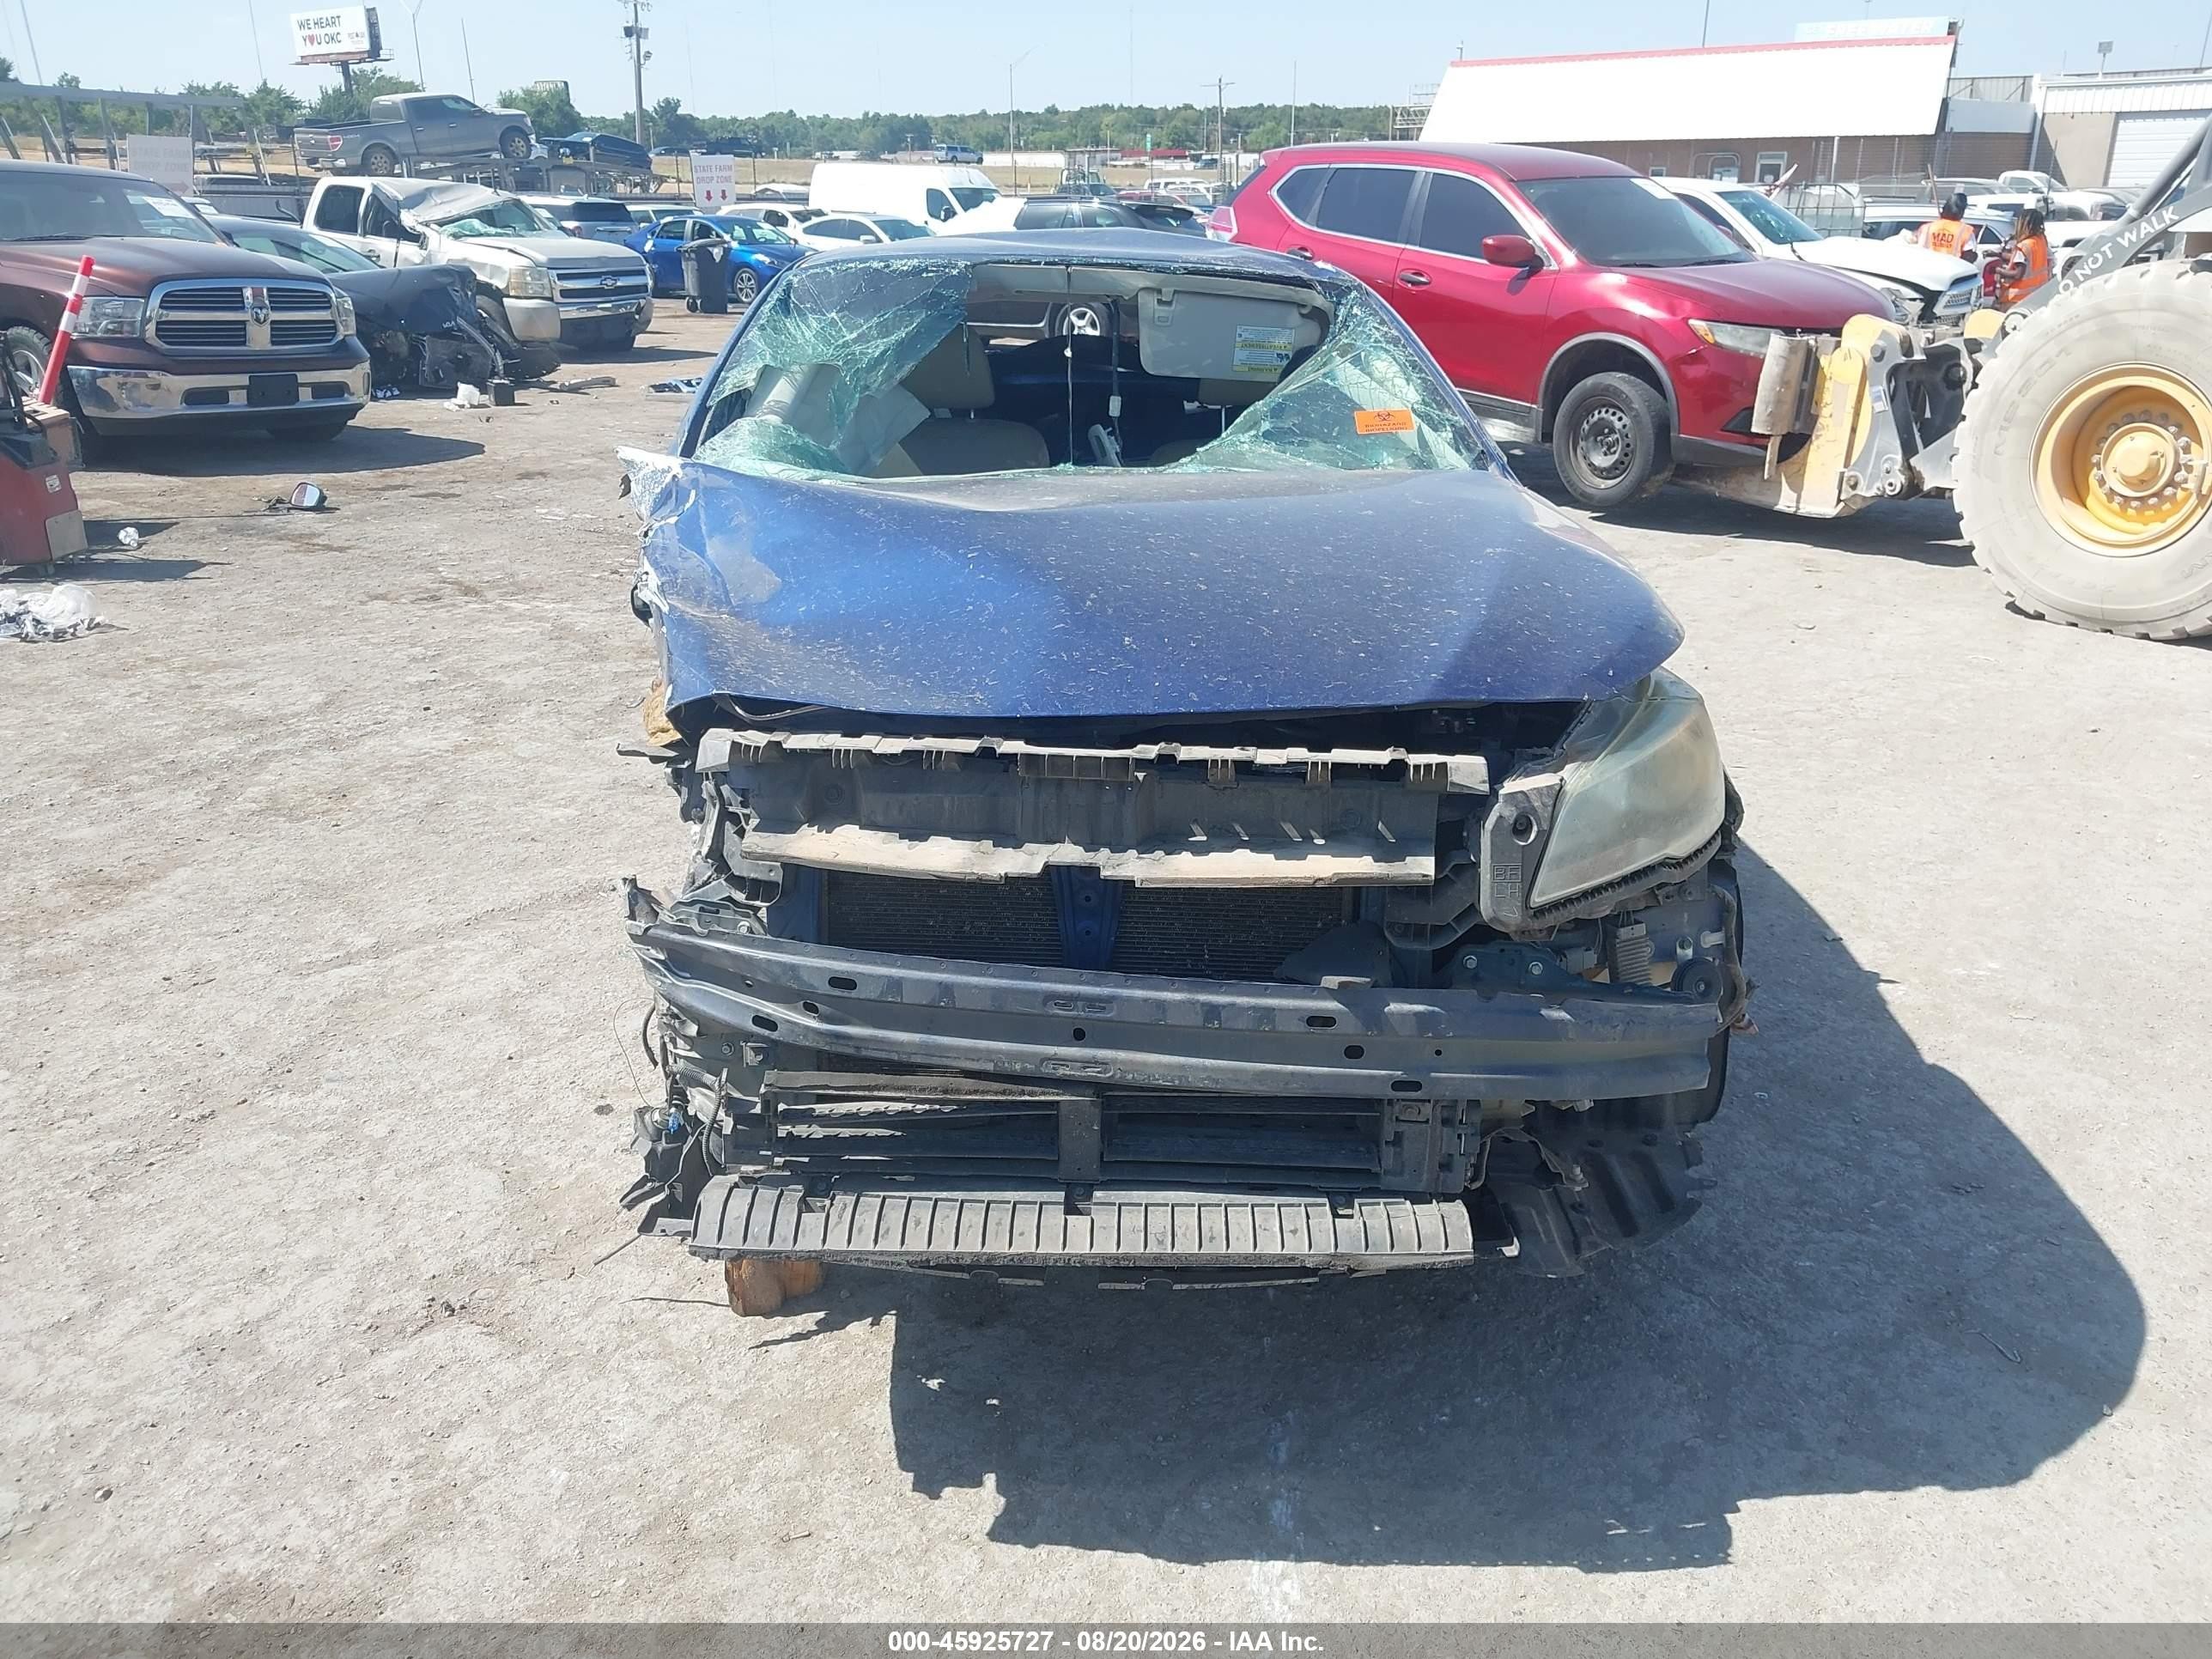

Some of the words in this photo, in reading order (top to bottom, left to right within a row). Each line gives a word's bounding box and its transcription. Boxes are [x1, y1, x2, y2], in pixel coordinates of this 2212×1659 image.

[296, 18, 312, 31] WE
[313, 15, 341, 30] HEART
[323, 32, 342, 45] OKC
[694, 165, 714, 173] STATE
[714, 164, 732, 173] FARM
[696, 175, 714, 185] DROP
[716, 174, 732, 184] ZONE
[2073, 242, 2113, 282] NOT
[2116, 205, 2179, 248] WALK
